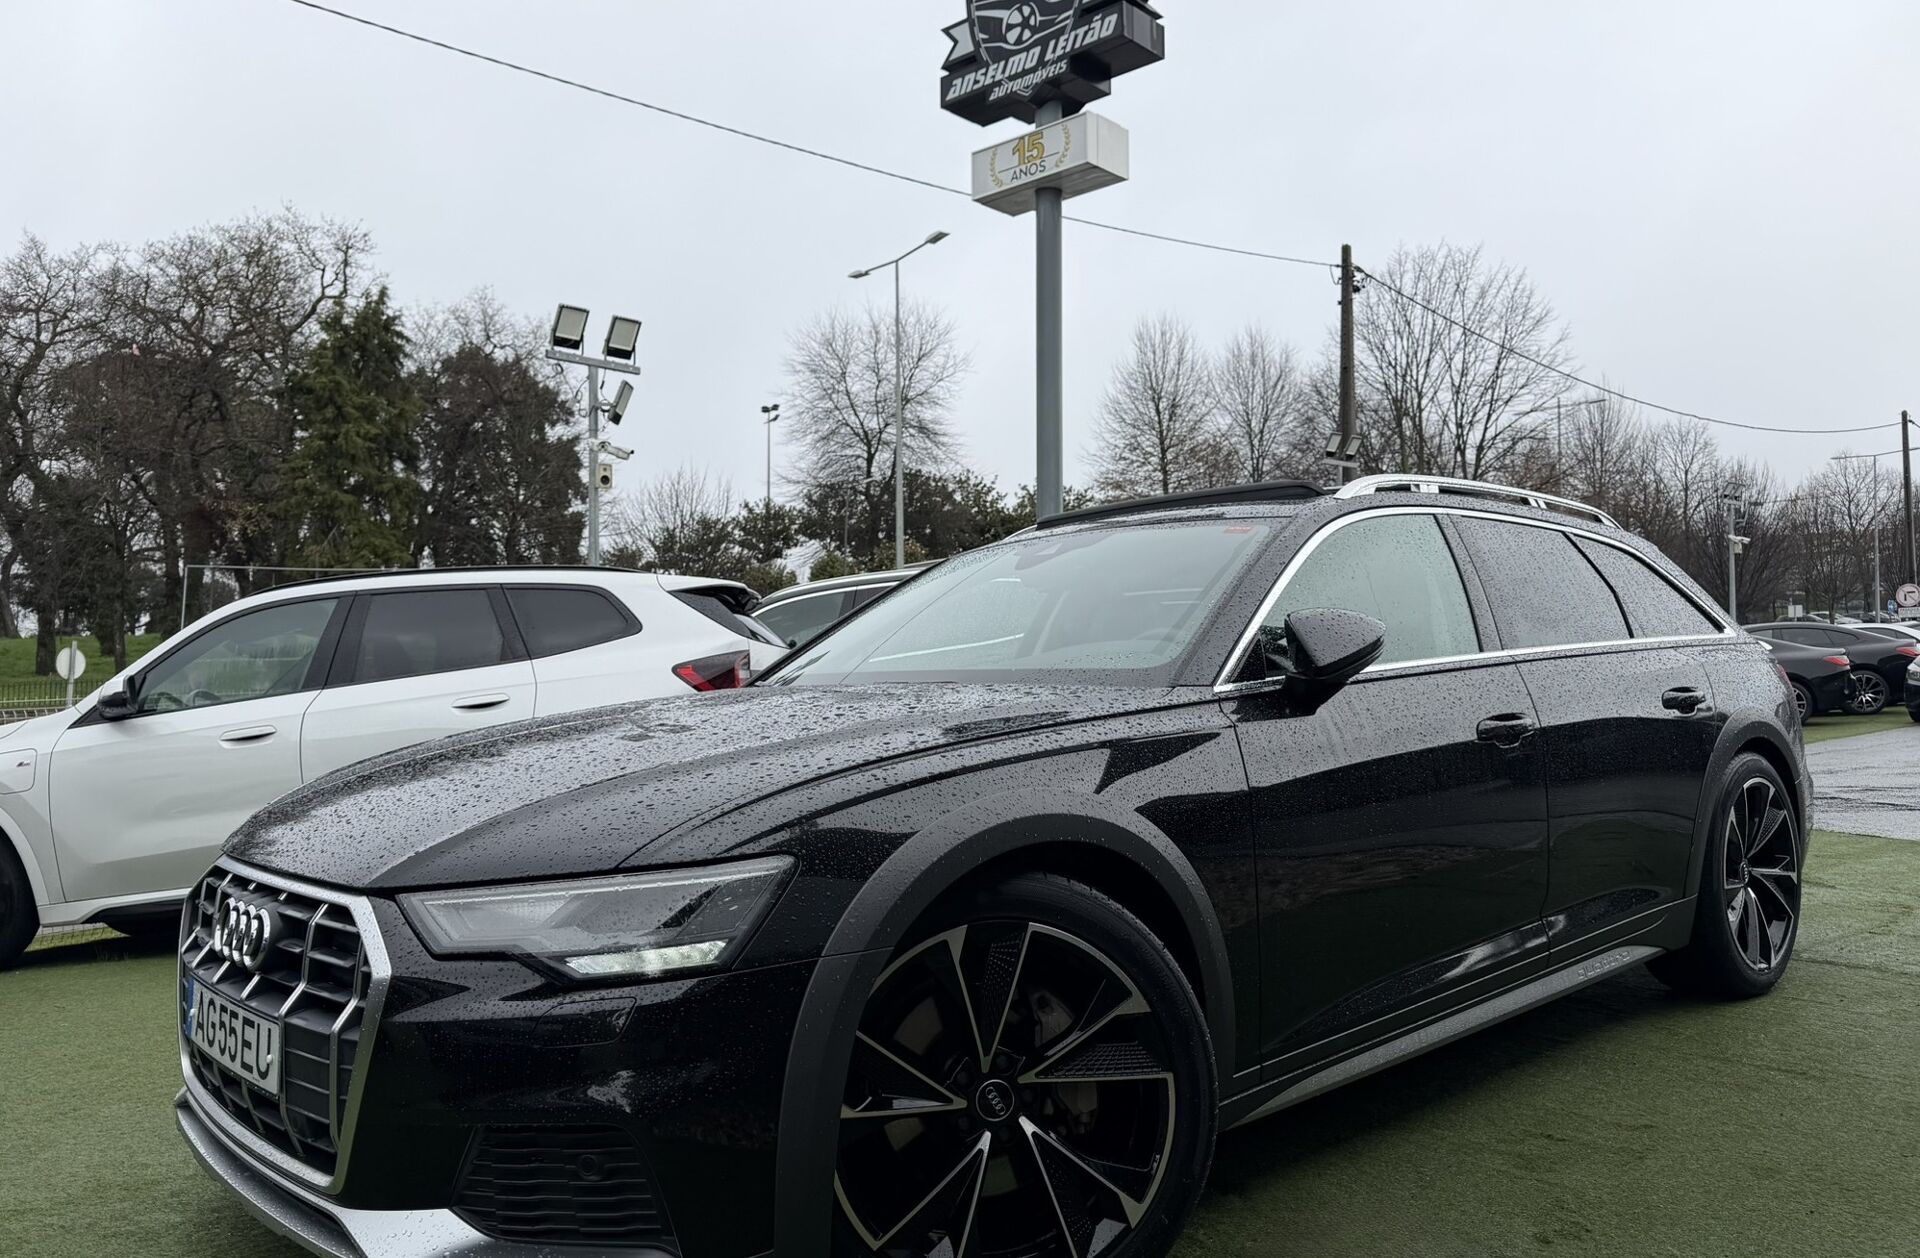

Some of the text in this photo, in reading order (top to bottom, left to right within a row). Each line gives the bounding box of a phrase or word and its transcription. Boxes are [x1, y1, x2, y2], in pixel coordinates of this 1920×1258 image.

[945, 45, 1042, 101] ANSELMO
[1012, 131, 1045, 166] 15
[1011, 159, 1047, 183] ANOS
